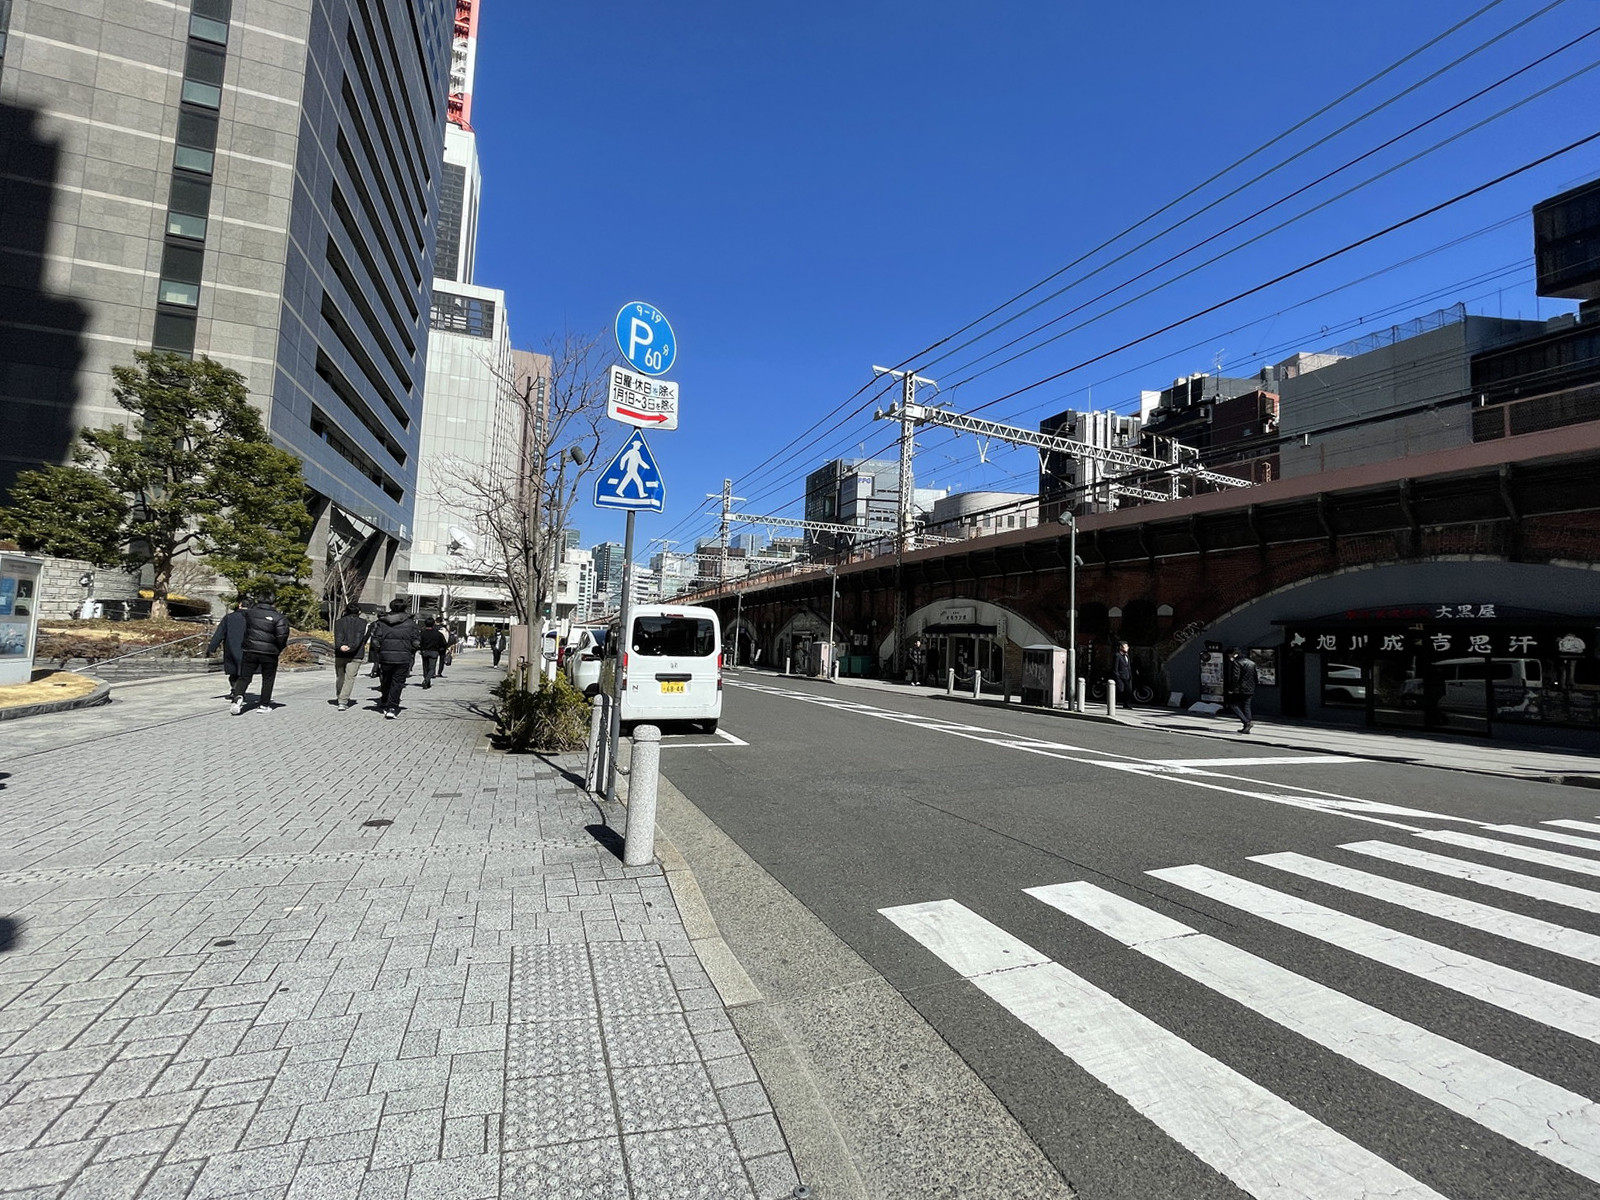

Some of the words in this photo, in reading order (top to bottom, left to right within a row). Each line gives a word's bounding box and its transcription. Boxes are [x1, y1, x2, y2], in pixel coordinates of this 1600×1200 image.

[636, 305, 662, 324] 9-19
[629, 316, 654, 360] P
[1435, 604, 1496, 618] 大黒屋
